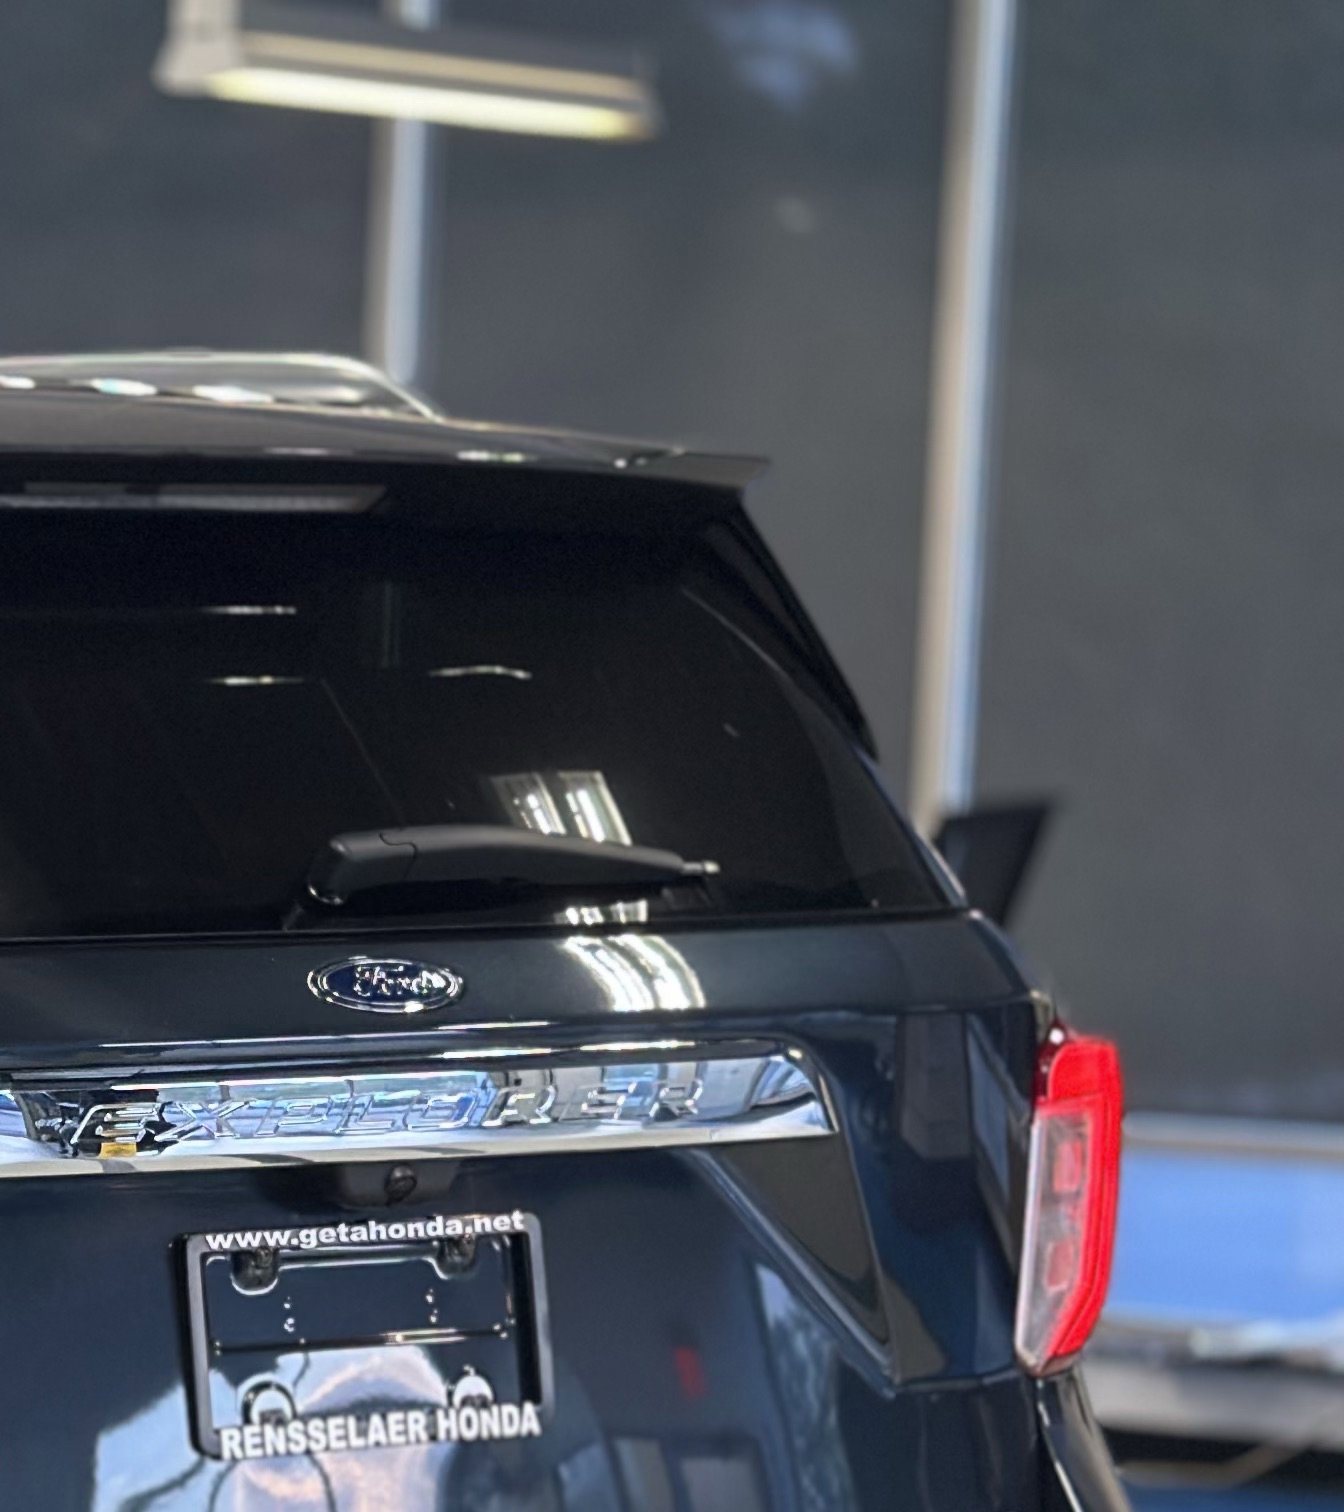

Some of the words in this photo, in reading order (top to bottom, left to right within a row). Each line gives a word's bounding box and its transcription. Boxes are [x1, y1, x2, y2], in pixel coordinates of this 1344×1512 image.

[353, 964, 448, 997] Ford
[70, 1076, 706, 1144] EXPLORER
[205, 1210, 525, 1250] www.getahonda.net
[220, 1408, 429, 1460] RENSSELAER
[436, 1402, 542, 1440] HONDA
